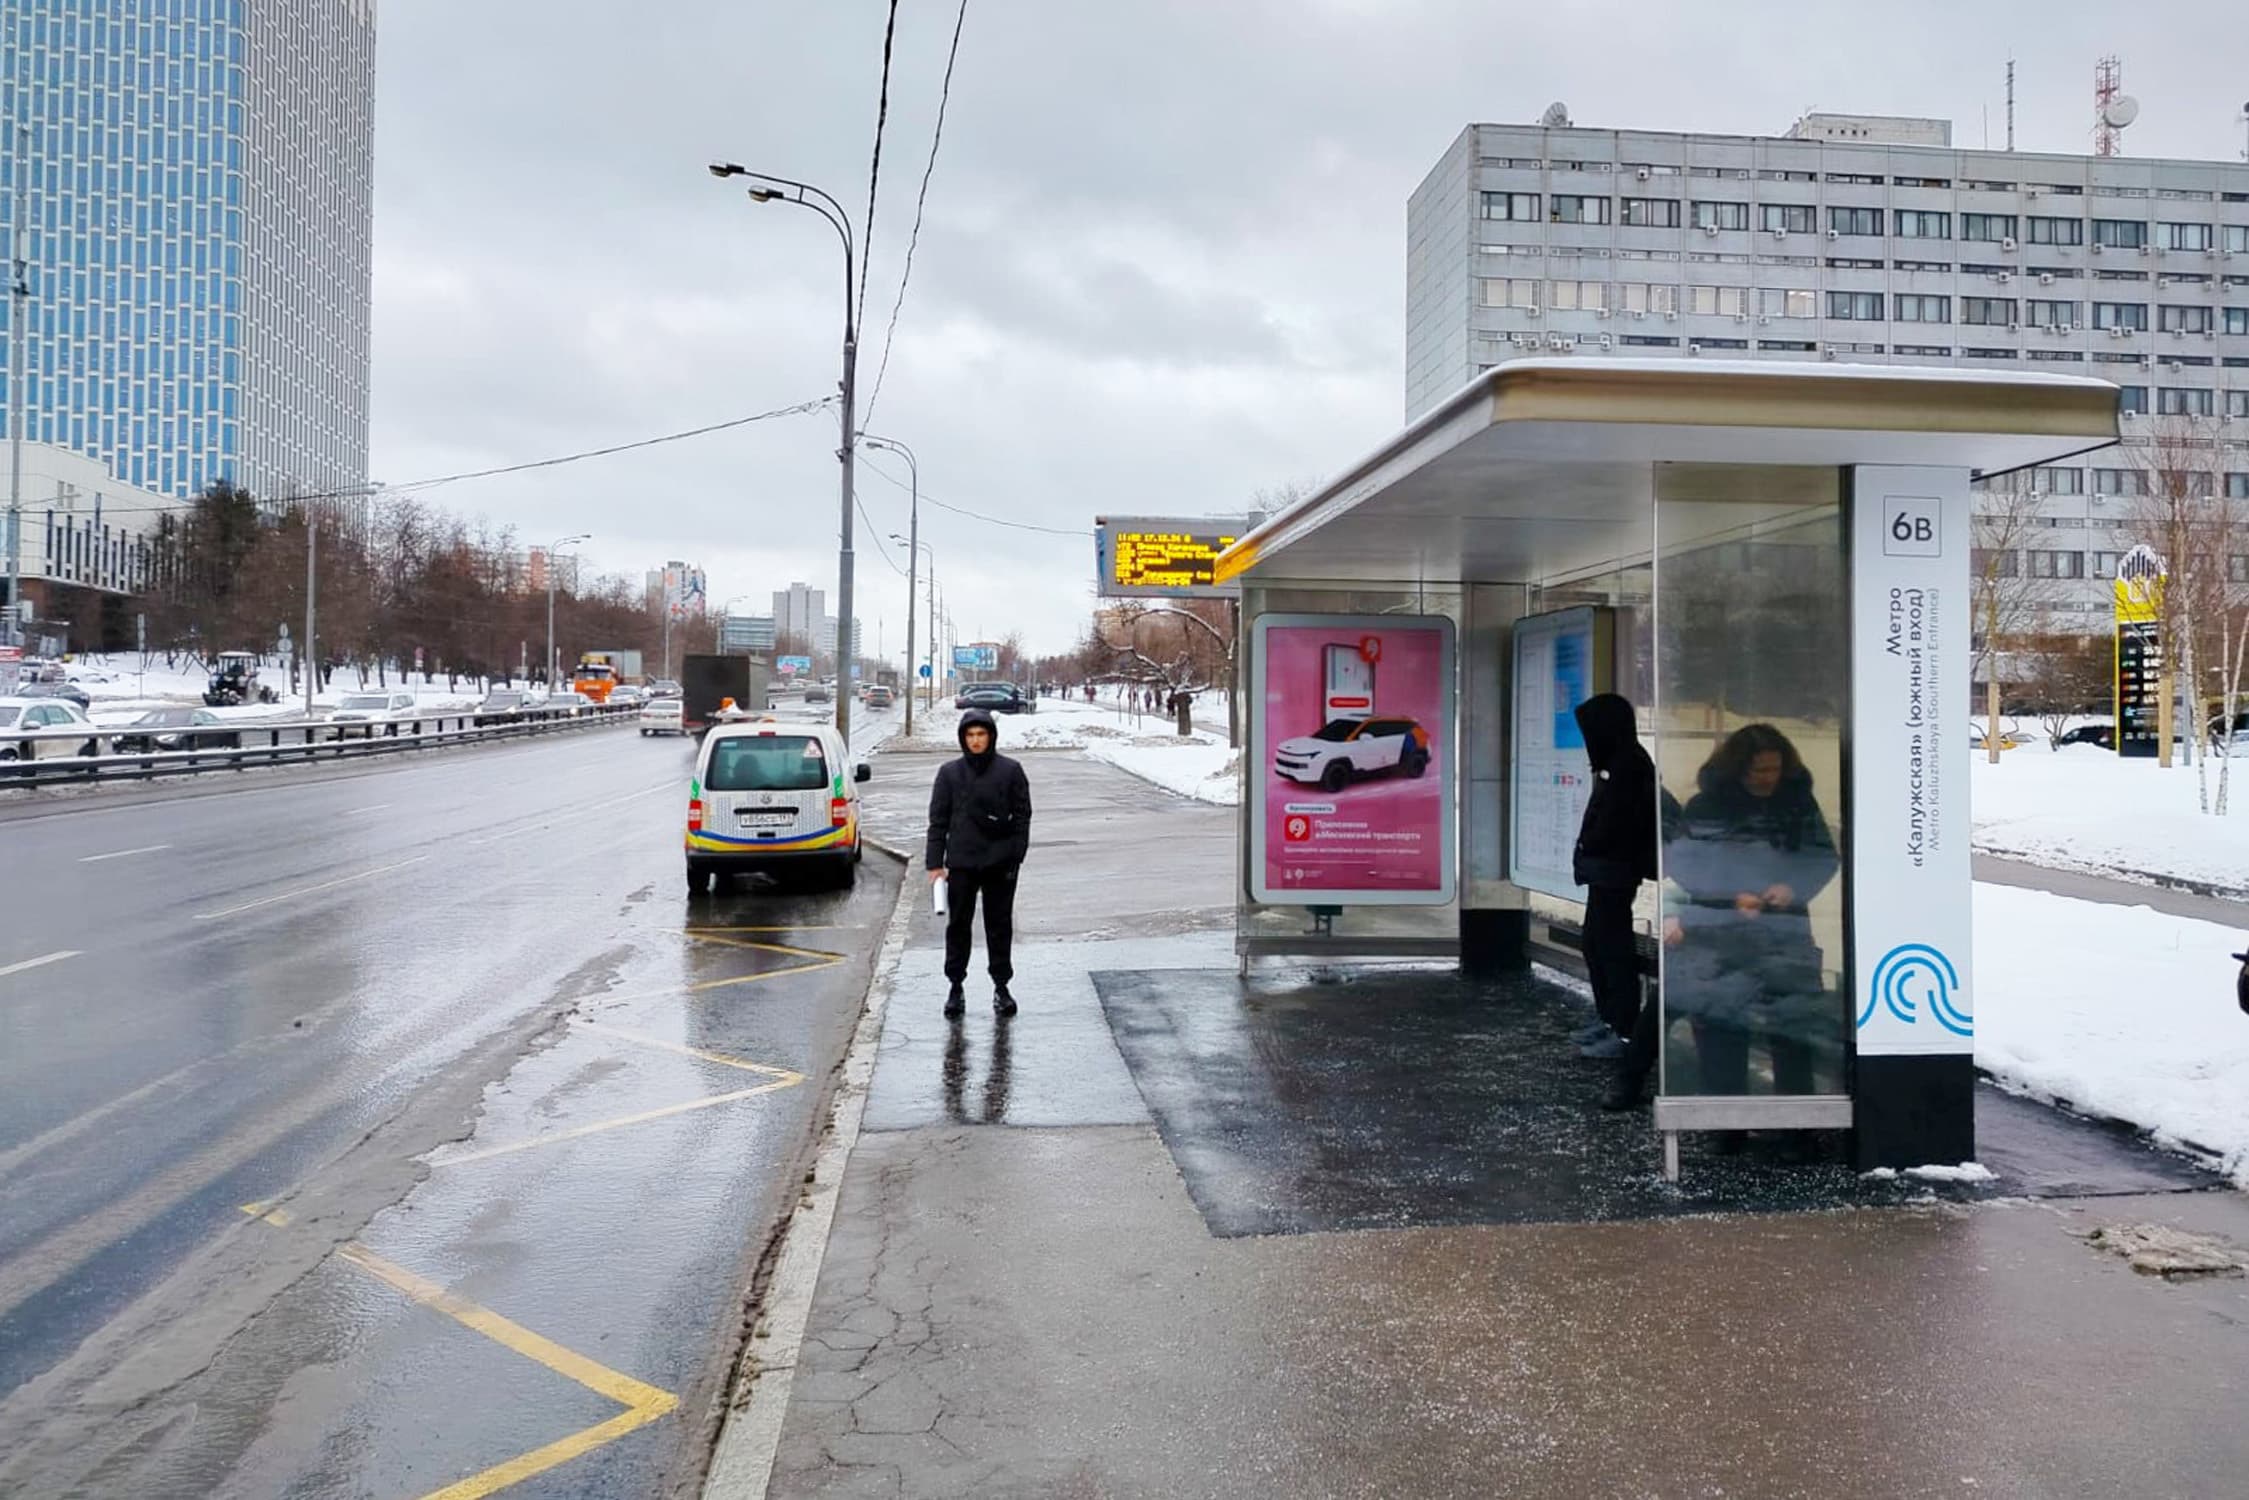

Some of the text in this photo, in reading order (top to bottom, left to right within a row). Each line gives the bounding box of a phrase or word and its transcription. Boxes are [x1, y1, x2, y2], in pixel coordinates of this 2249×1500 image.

[1886, 587, 1906, 656] Метро
[1905, 587, 1927, 868] «Калужская» (южный вход)
[1927, 588, 1942, 851] Metro Kaluzhskaya (Southern Entrance)
